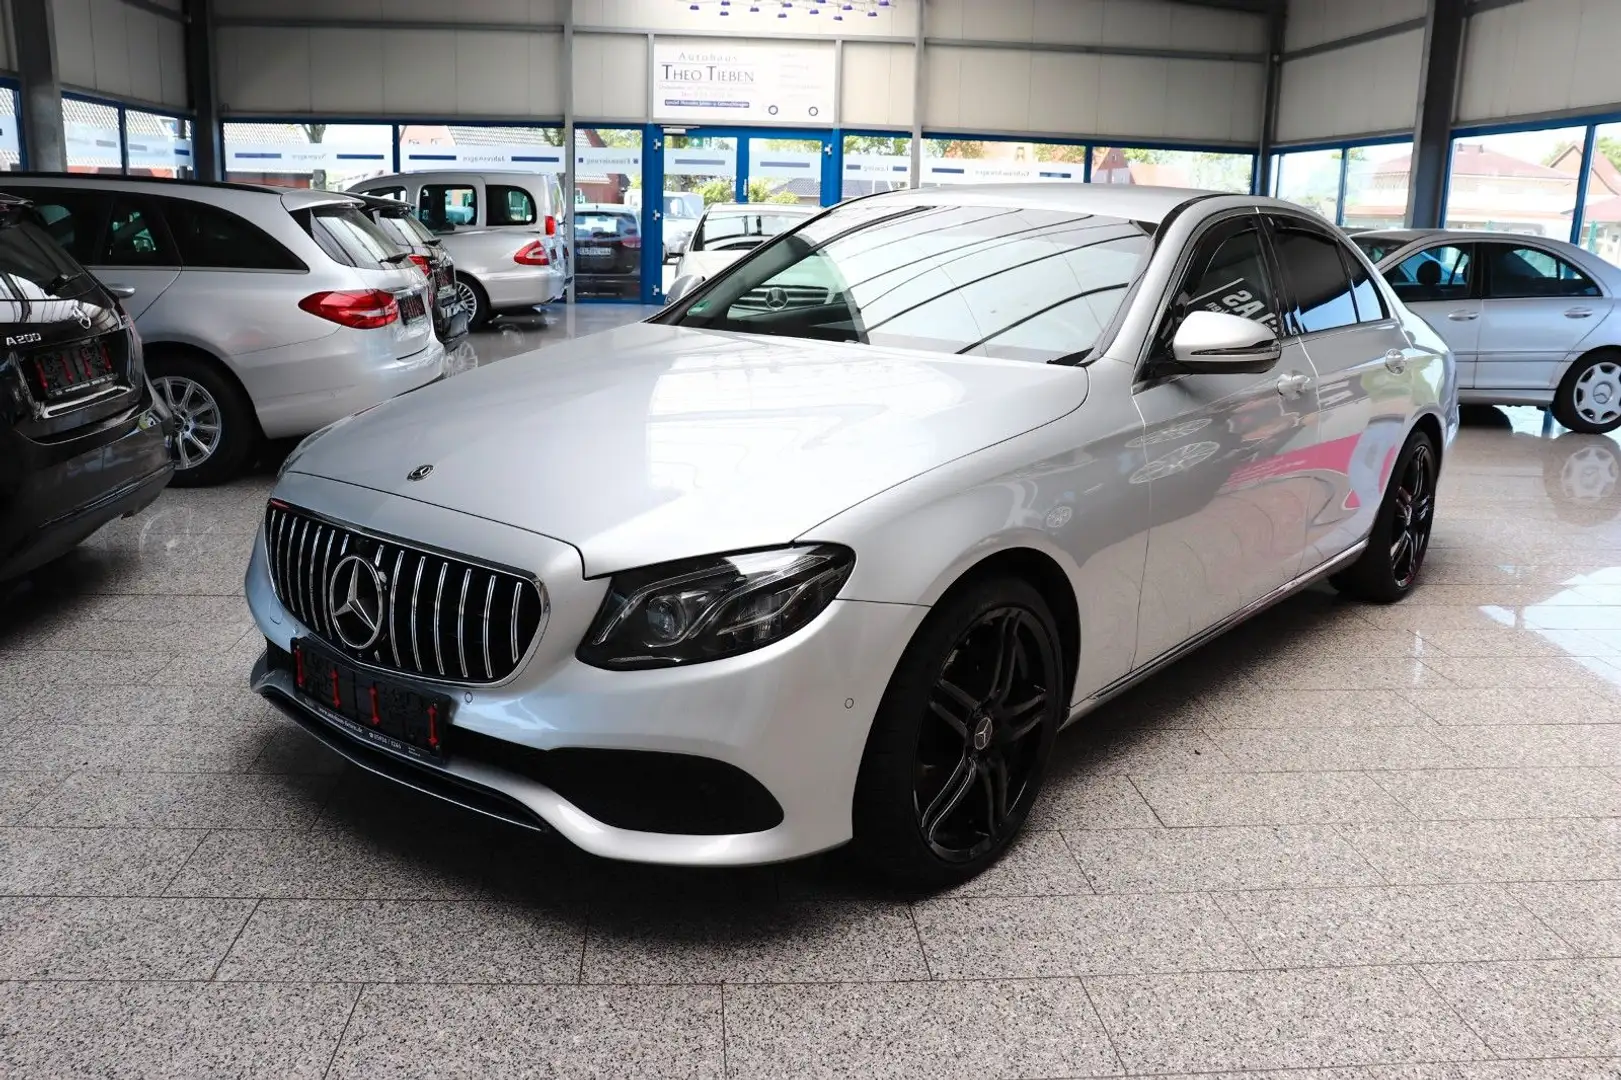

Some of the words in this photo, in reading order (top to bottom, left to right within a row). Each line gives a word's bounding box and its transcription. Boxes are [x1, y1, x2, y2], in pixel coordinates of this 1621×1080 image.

[679, 52, 738, 62] Autohaus
[661, 64, 702, 81] THEO
[706, 66, 754, 82] TIEBEN
